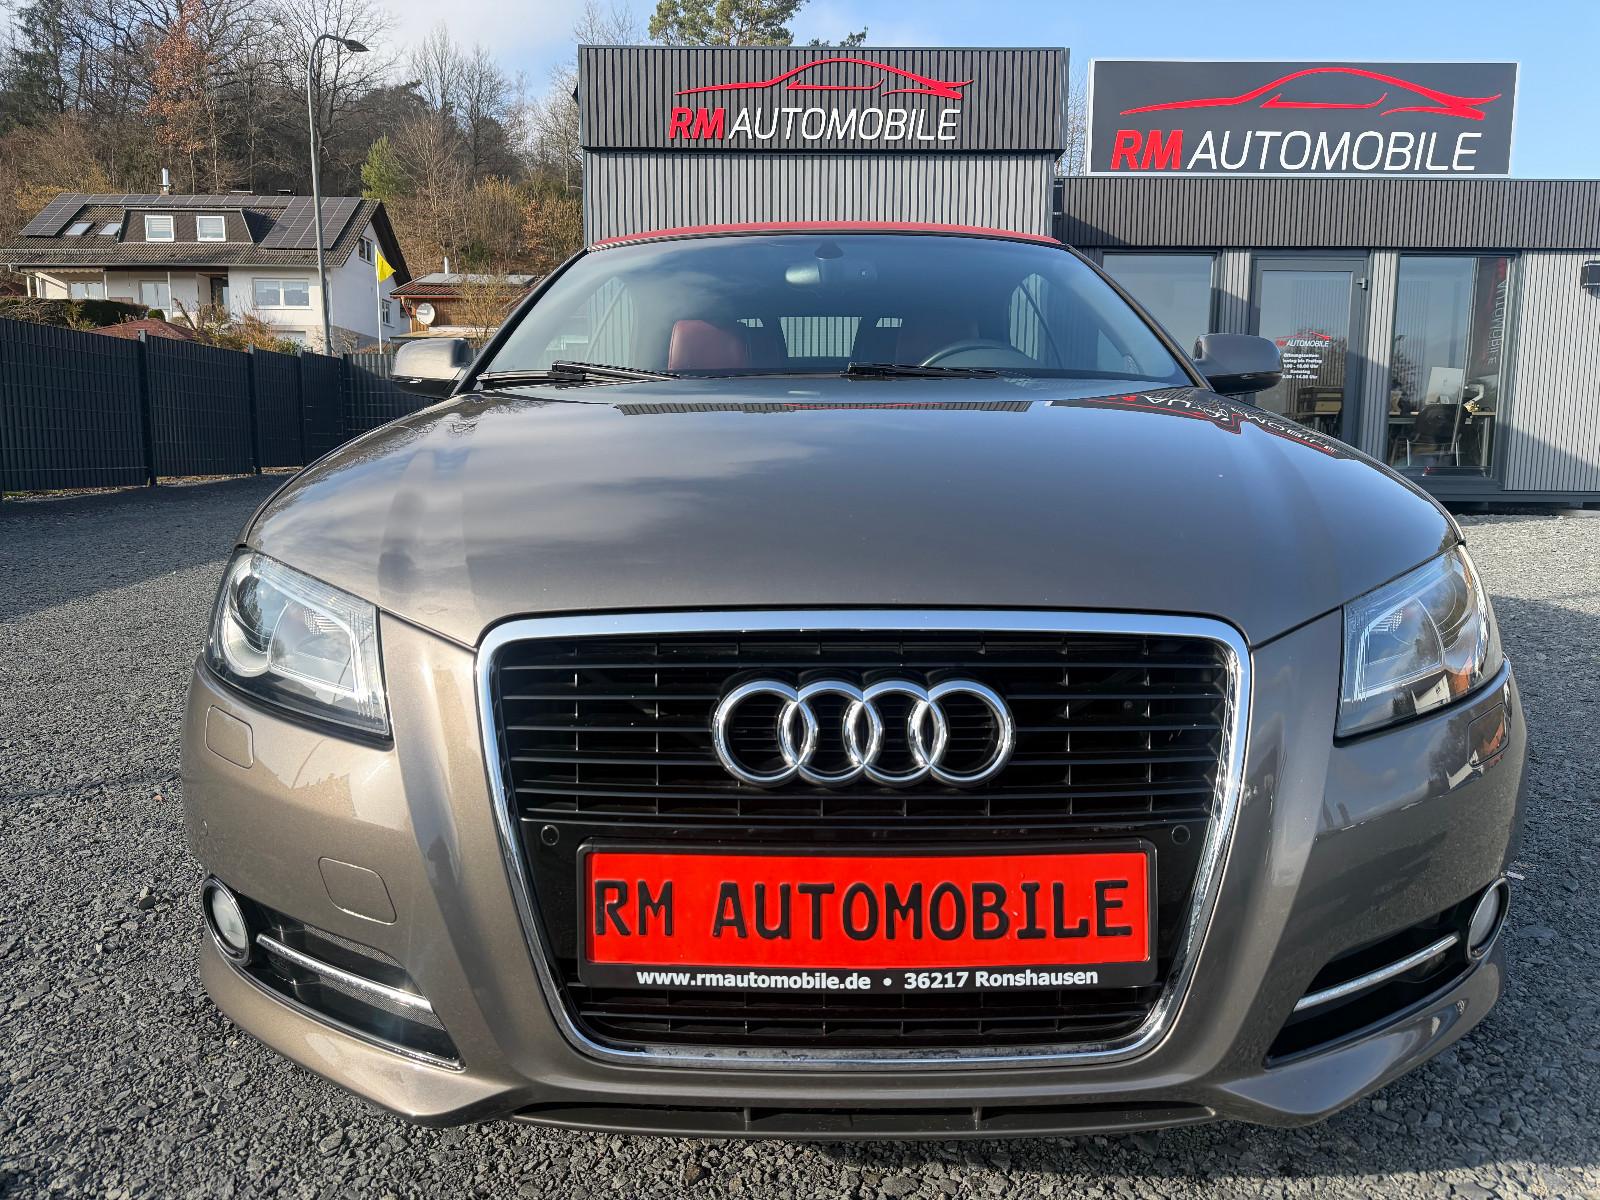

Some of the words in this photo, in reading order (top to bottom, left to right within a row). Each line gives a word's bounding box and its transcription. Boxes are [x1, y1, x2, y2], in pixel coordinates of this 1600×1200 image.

[668, 107, 726, 140] RM
[728, 107, 961, 141] AUTOMOBILE
[1110, 129, 1184, 170] RM
[1186, 130, 1483, 171] AUTOMOBILE
[1286, 340, 1330, 348] AUTOMOBILE
[593, 879, 674, 938] RM
[712, 878, 1133, 942] AUTOMOBILE
[636, 971, 871, 990] www.rmautomobile.de
[903, 971, 969, 989] 36217
[975, 969, 1098, 987] Ronshausen
